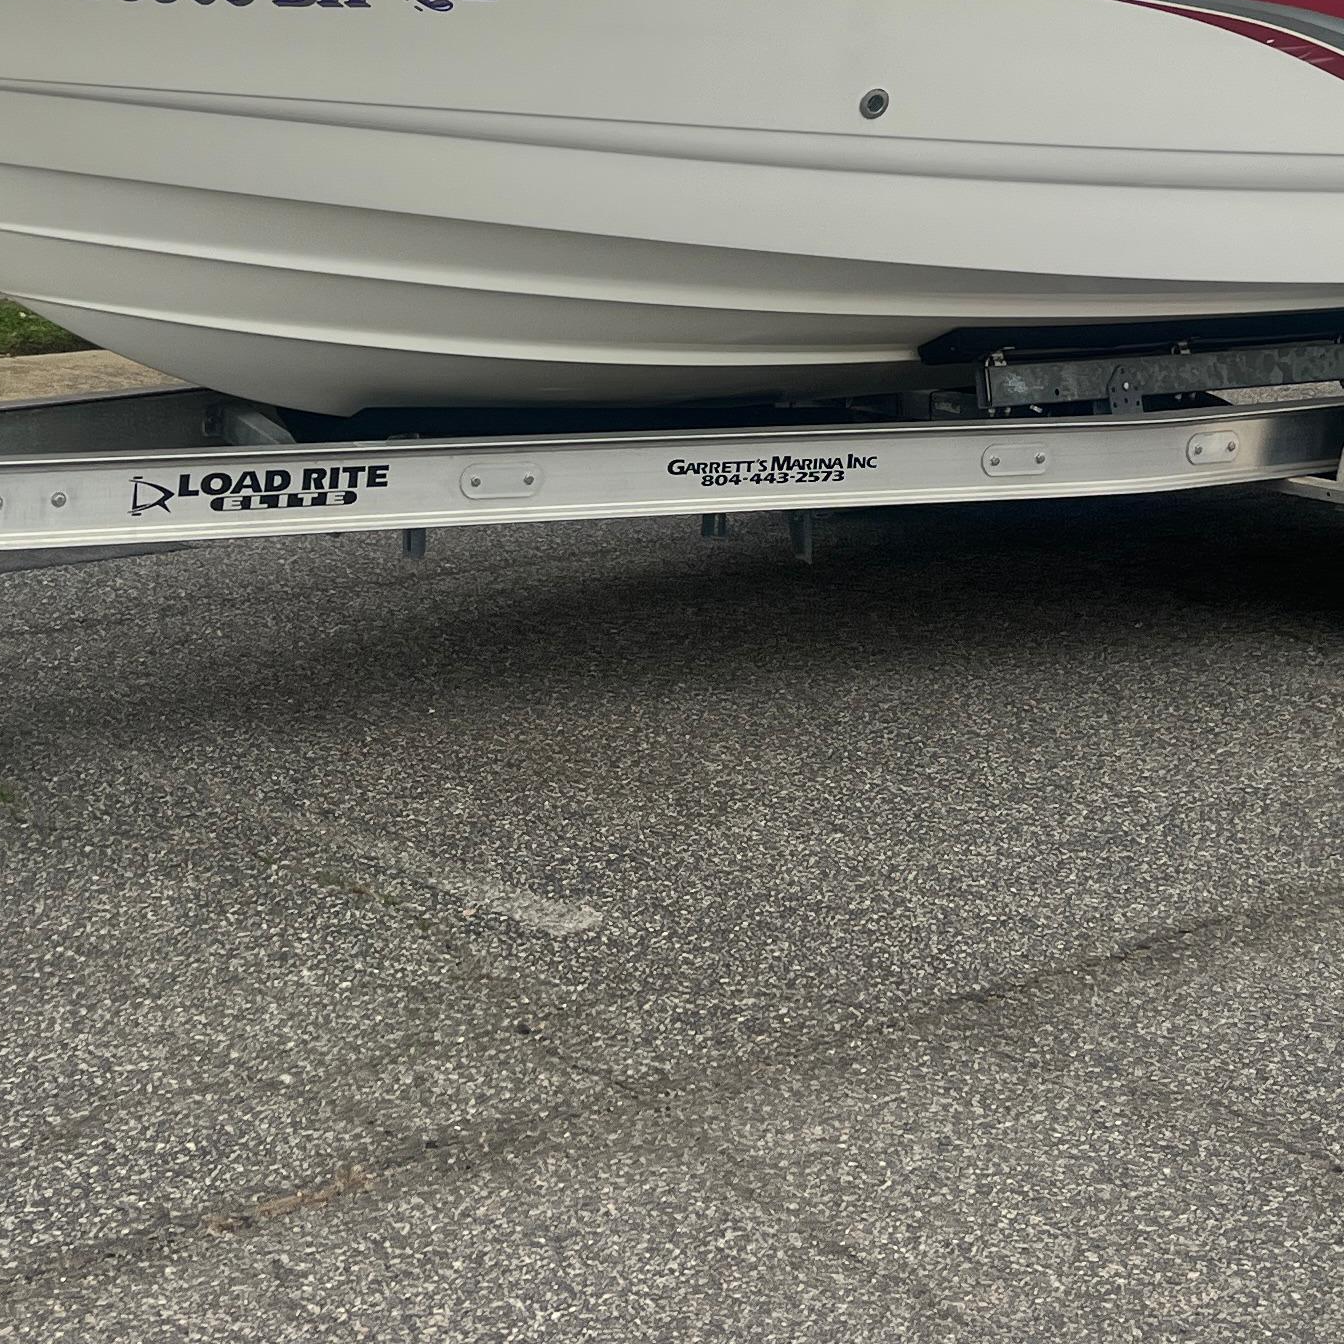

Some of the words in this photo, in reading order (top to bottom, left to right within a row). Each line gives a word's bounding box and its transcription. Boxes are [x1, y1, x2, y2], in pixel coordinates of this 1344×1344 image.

[177, 469, 292, 498] LOAD
[301, 464, 390, 491] RITE
[701, 470, 845, 487] 804-443-2573
[221, 491, 347, 511] ELITE
